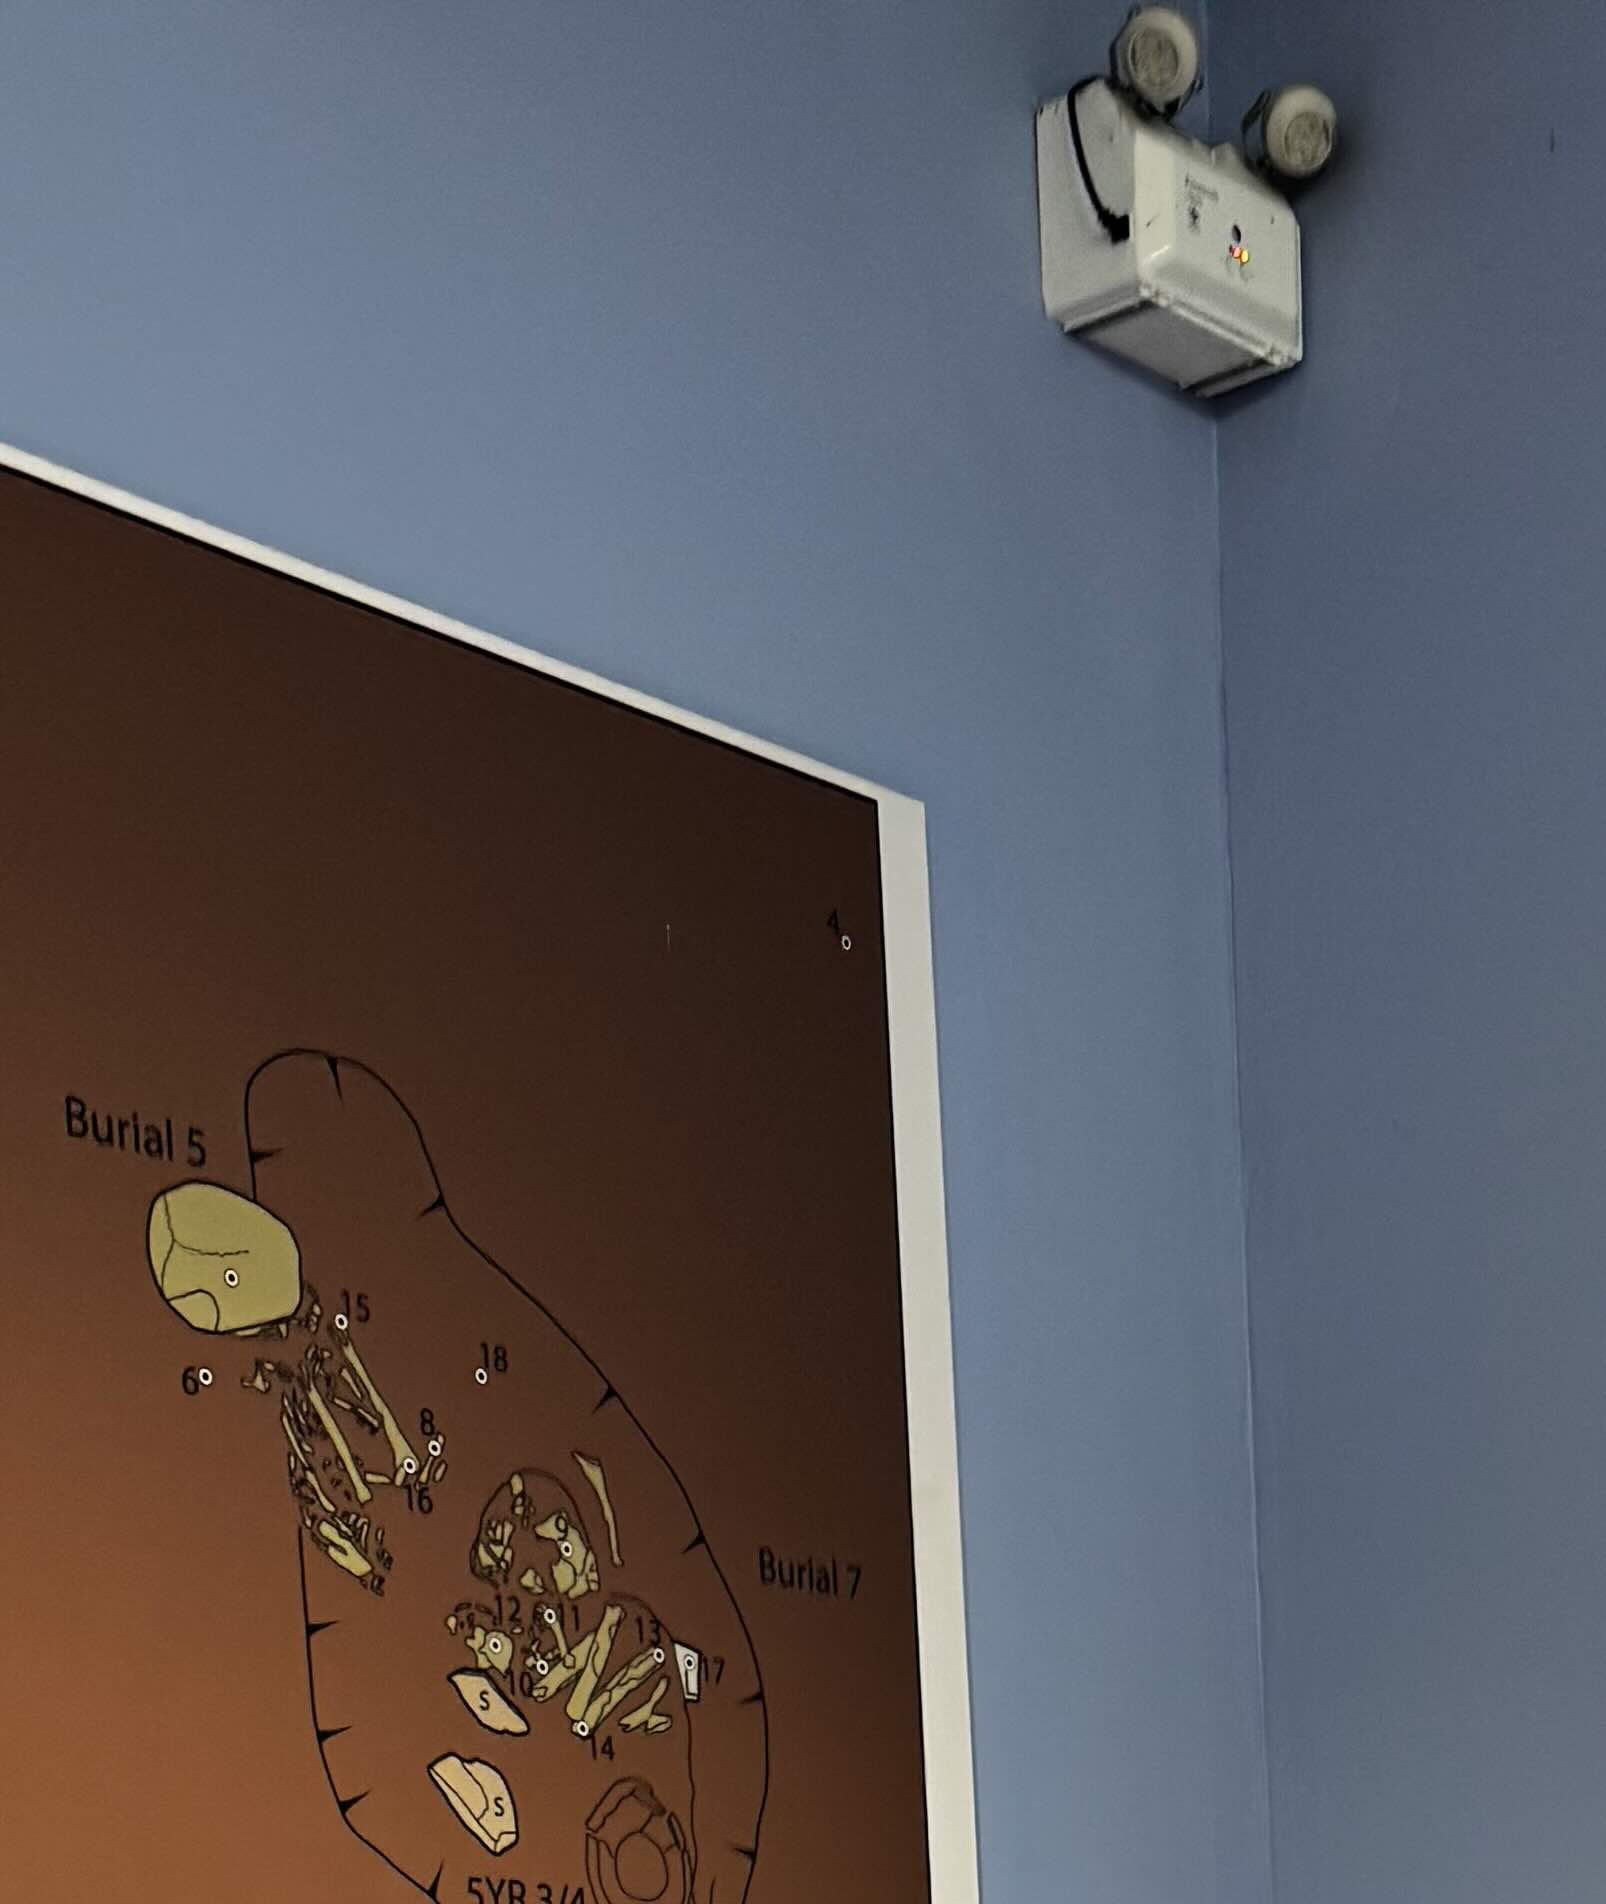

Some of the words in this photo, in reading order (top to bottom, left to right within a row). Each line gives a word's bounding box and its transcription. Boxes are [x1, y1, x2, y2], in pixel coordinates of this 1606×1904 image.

[66, 1096, 173, 1161] Burial
[186, 1127, 207, 1167] 5
[481, 1342, 507, 1372] 18
[182, 1367, 199, 1395] 6
[421, 1408, 434, 1436] 8
[759, 1545, 838, 1597] Burial
[847, 1563, 862, 1600] 7
